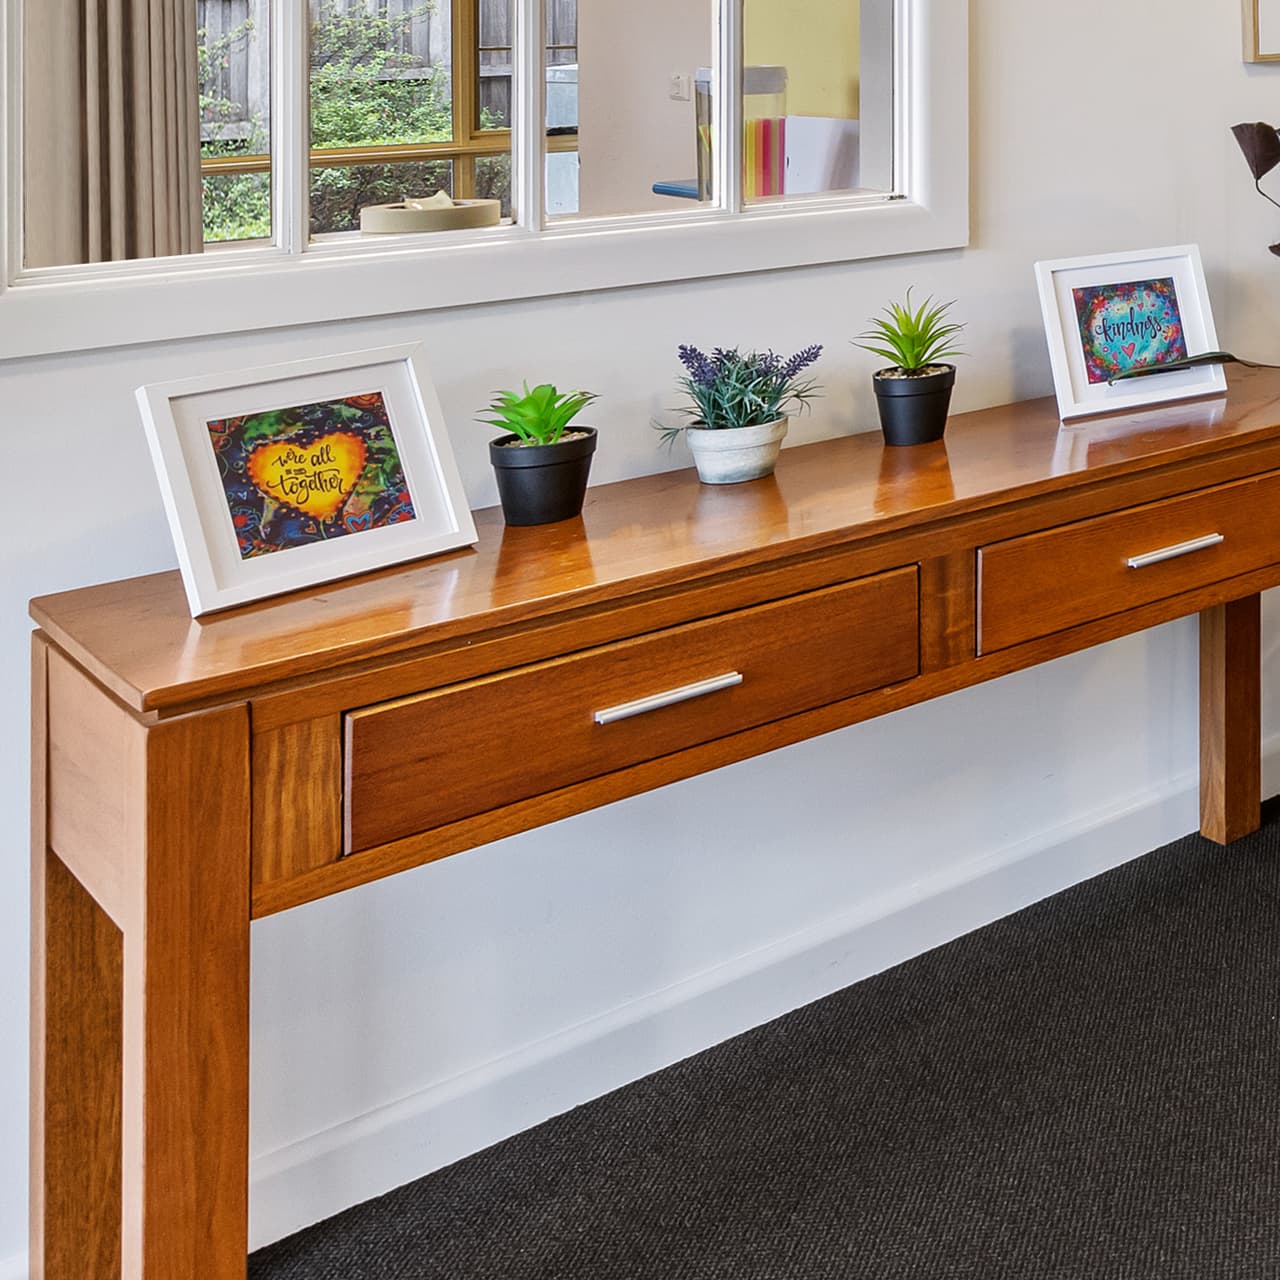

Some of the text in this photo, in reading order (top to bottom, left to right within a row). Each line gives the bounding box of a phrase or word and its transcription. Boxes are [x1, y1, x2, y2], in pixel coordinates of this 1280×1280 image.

[1096, 306, 1166, 342] kindness
[310, 444, 336, 466] all
[266, 469, 348, 505] together
